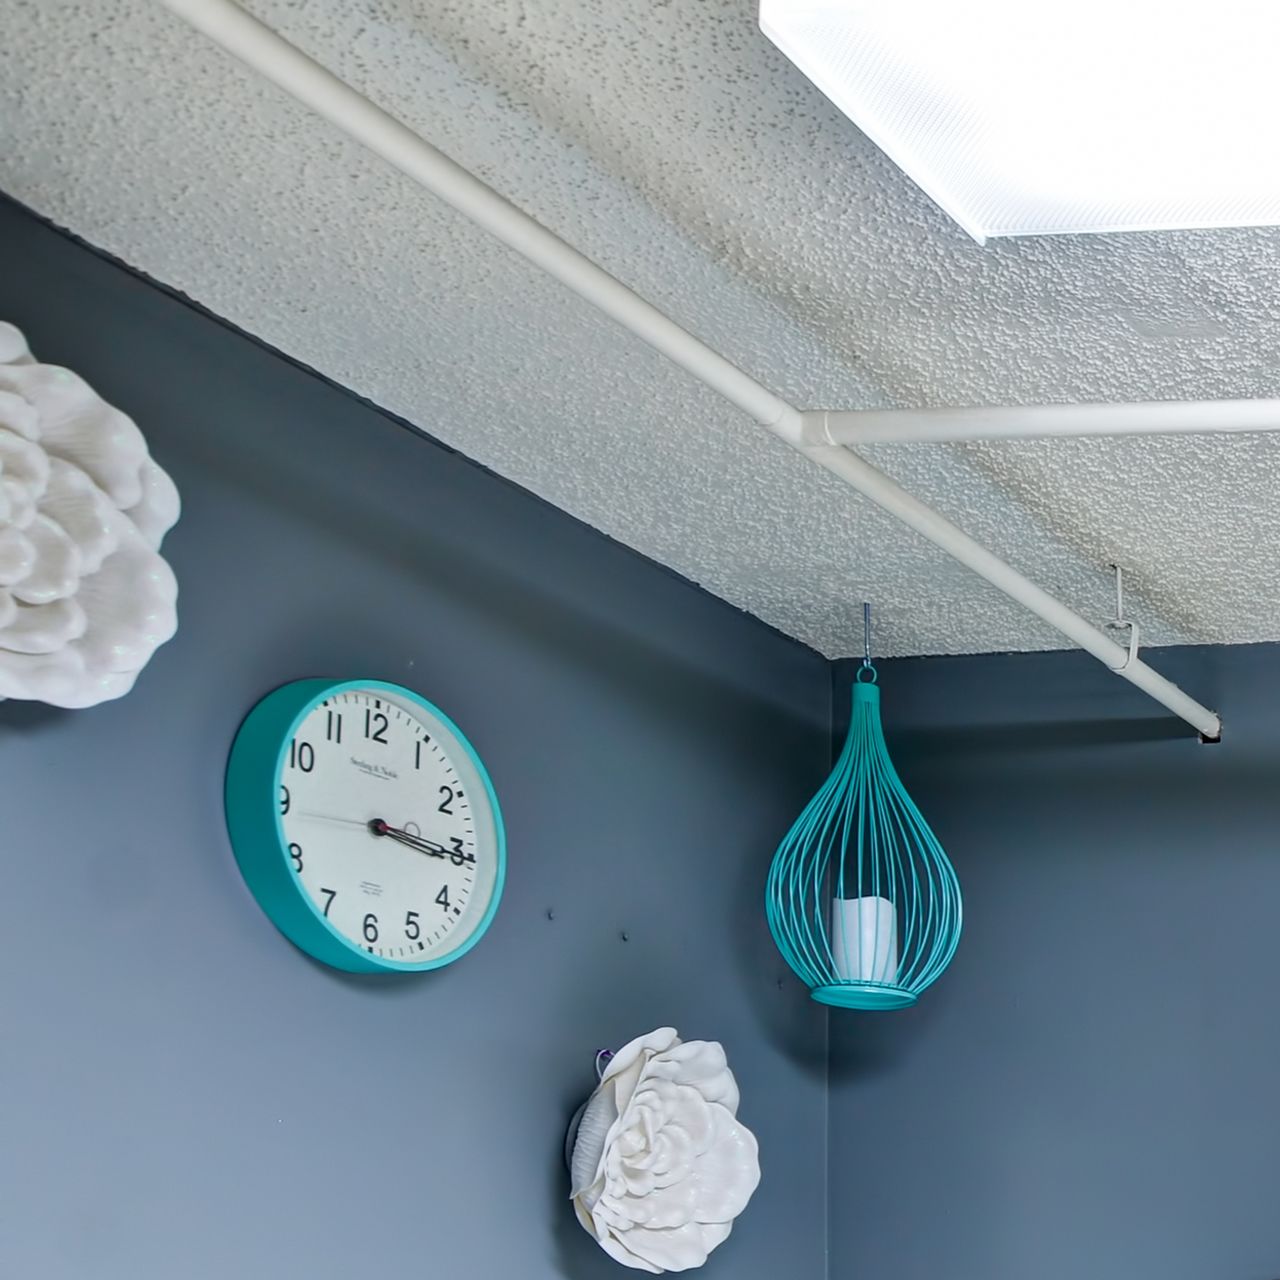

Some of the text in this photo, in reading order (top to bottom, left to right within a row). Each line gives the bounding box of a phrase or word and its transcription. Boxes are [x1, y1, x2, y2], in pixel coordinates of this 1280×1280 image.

[327, 710, 342, 744] 11
[365, 709, 388, 744] 12
[290, 738, 314, 772] 10
[414, 740, 420, 770] 1
[438, 785, 453, 815] 2
[288, 842, 303, 873] 8
[450, 837, 466, 866] 3
[320, 888, 336, 917] 7
[435, 884, 450, 912] 4
[363, 913, 378, 943] 6
[405, 911, 420, 940] 5
